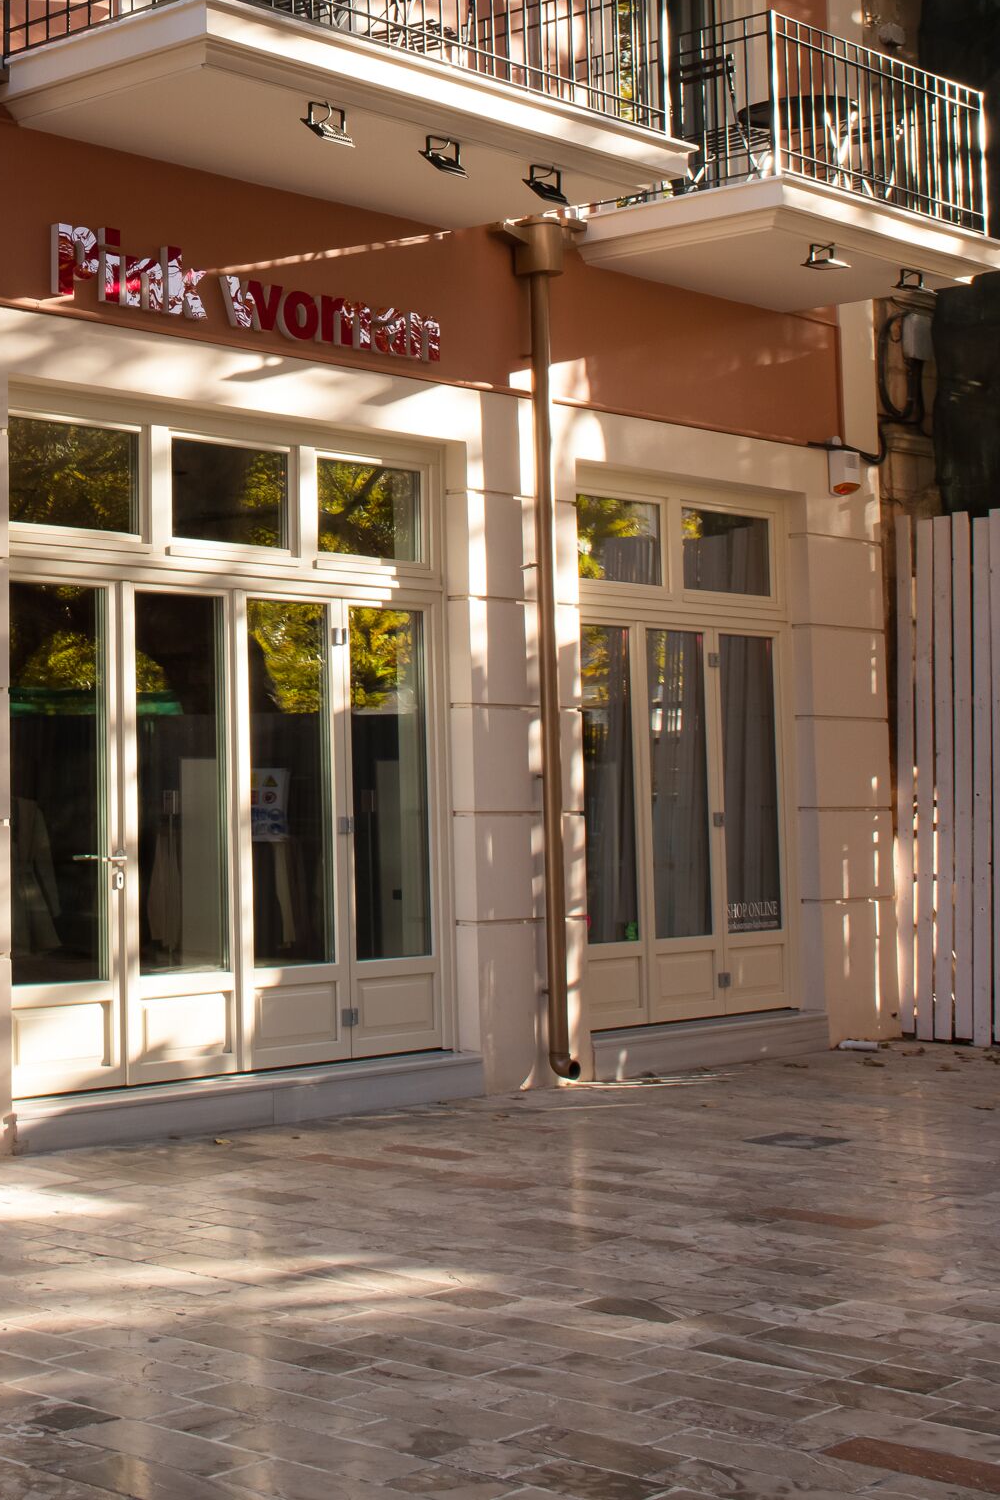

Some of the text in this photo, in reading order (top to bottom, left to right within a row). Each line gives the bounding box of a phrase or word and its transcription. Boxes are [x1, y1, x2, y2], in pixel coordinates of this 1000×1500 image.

[50, 222, 441, 362] Pink woman
[748, 901, 778, 917] ONLINE
